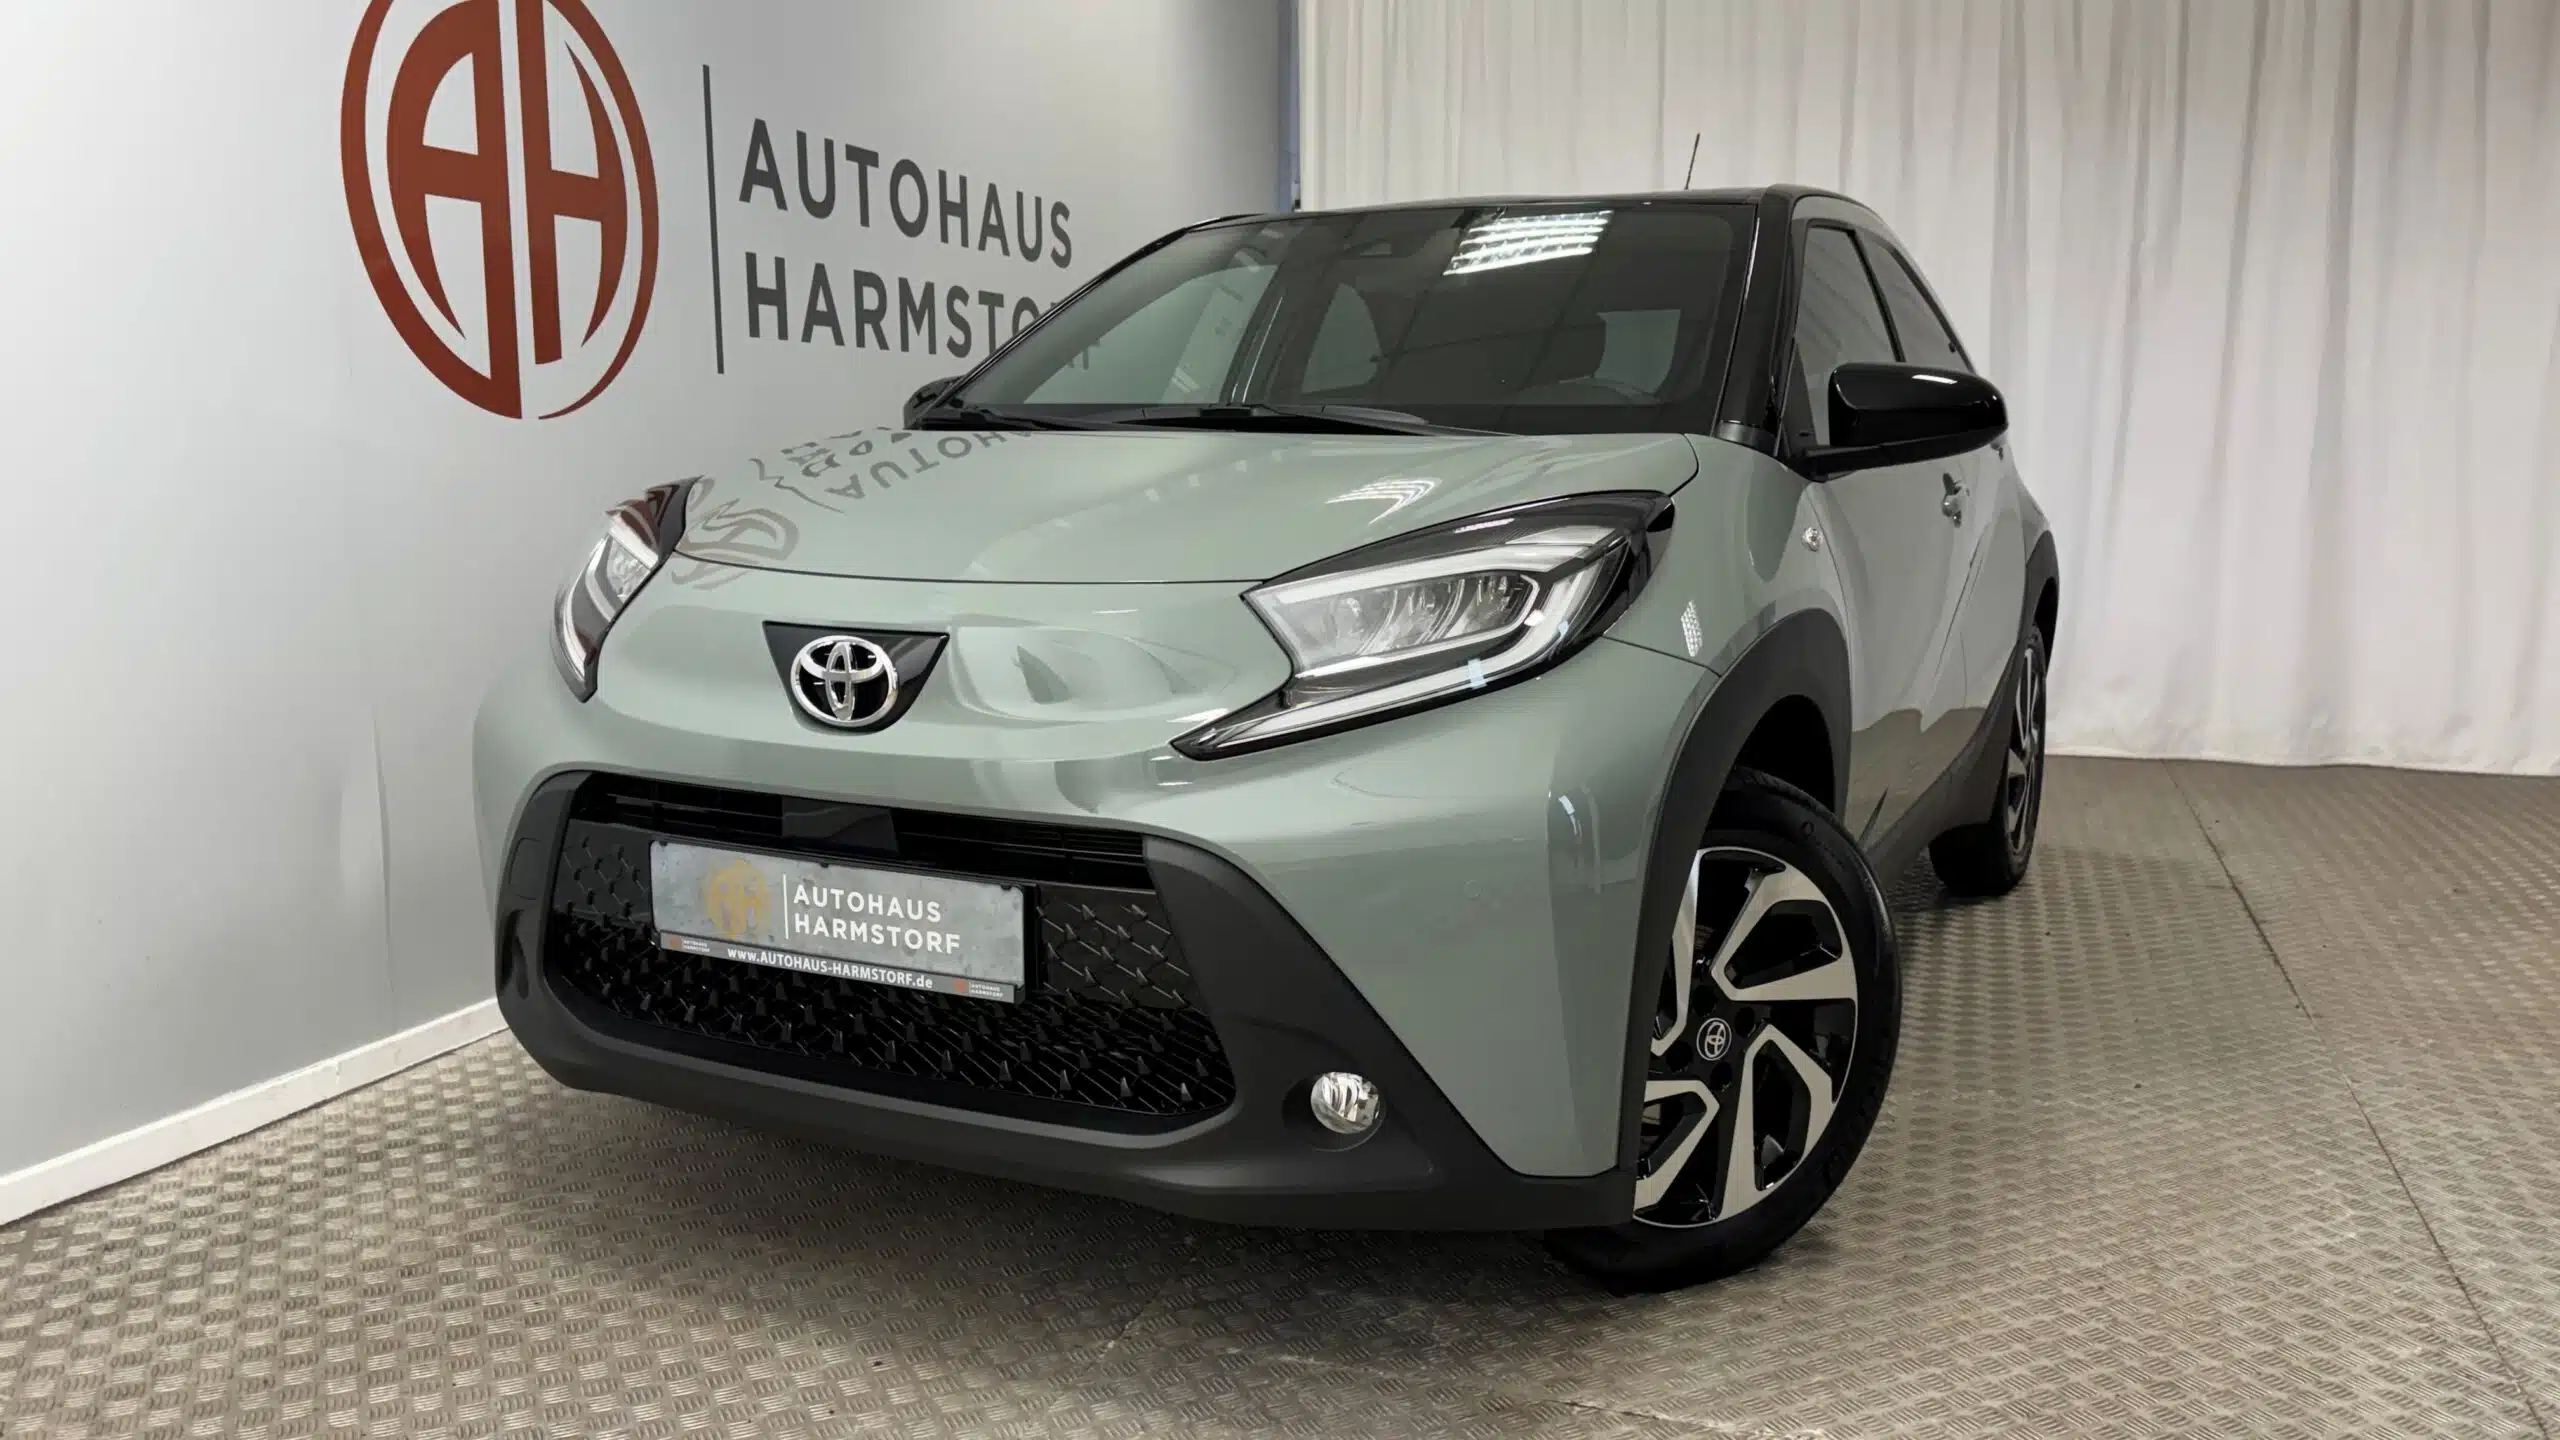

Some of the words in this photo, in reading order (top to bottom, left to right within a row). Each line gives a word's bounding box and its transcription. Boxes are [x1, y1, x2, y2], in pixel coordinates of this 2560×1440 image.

[738, 118, 1072, 269] AUTOHAUS
[744, 251, 1100, 372] HARMST
[792, 884, 942, 923] AUTOHAUS
[794, 914, 961, 955] HARMSTORF
[727, 947, 933, 990] www.AUTOHAUS-HARMSTORF.de
